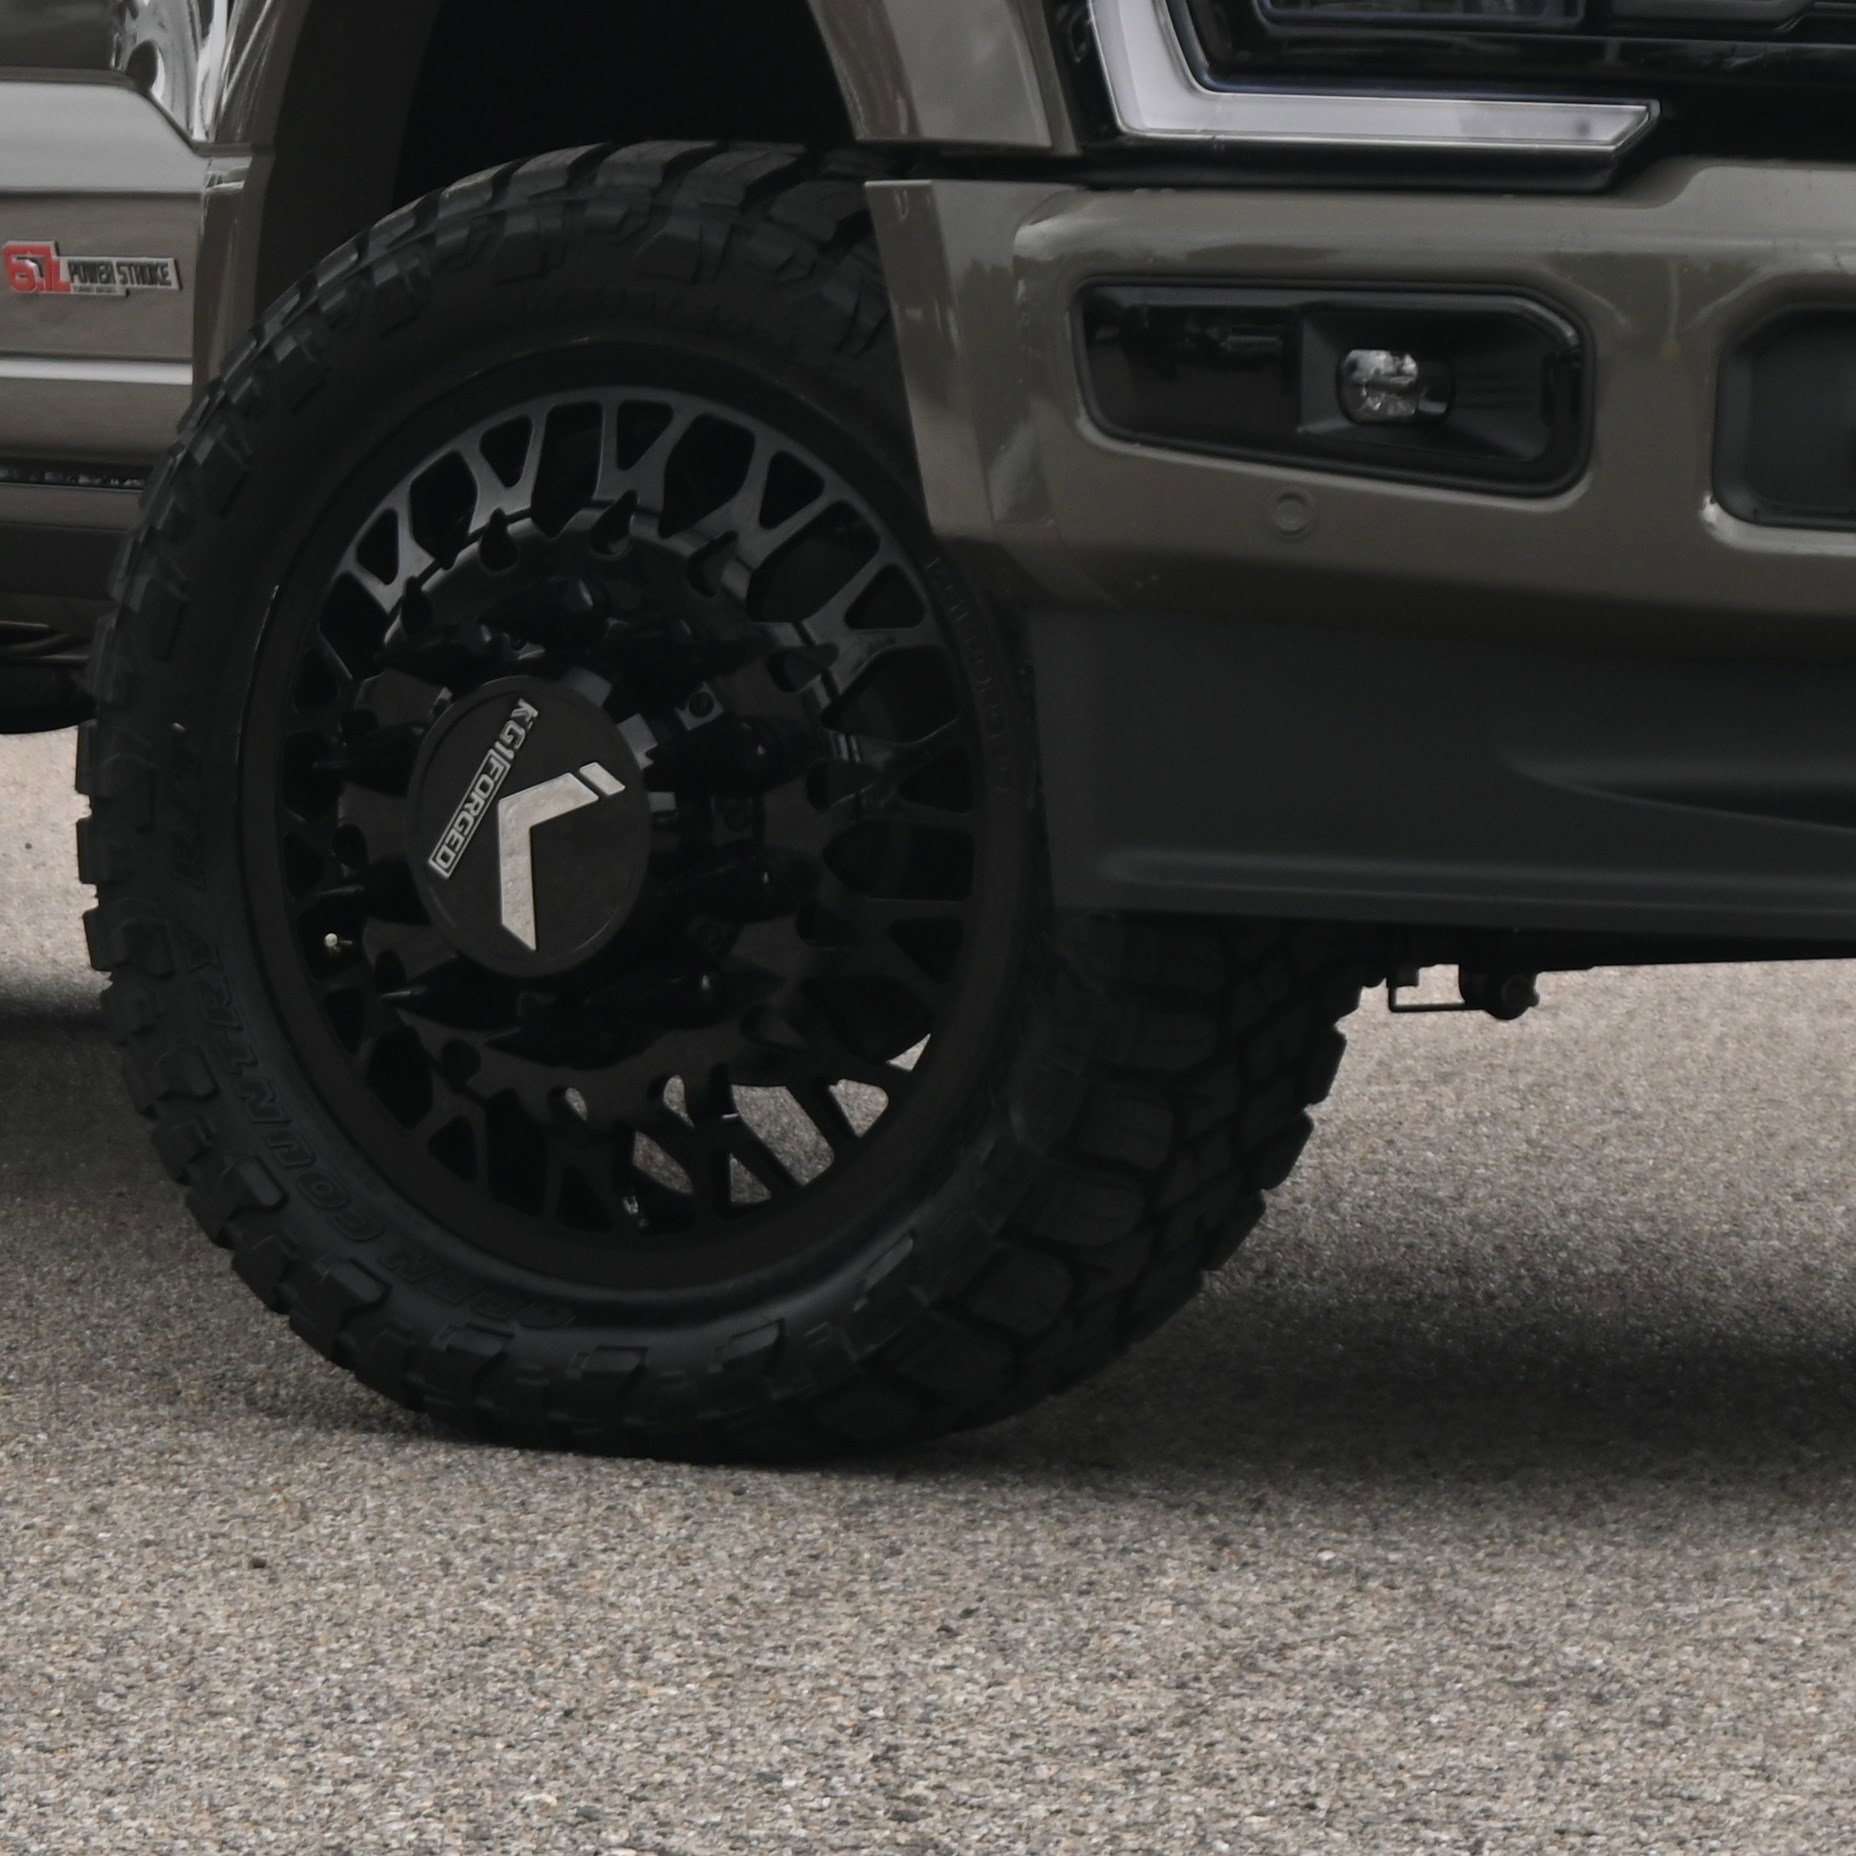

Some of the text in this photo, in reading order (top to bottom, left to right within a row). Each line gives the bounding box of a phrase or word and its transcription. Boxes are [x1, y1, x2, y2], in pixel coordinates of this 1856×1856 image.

[67, 259, 117, 285] POWER
[116, 261, 172, 287] STROKE
[431, 697, 539, 877] KG1 FORGED
